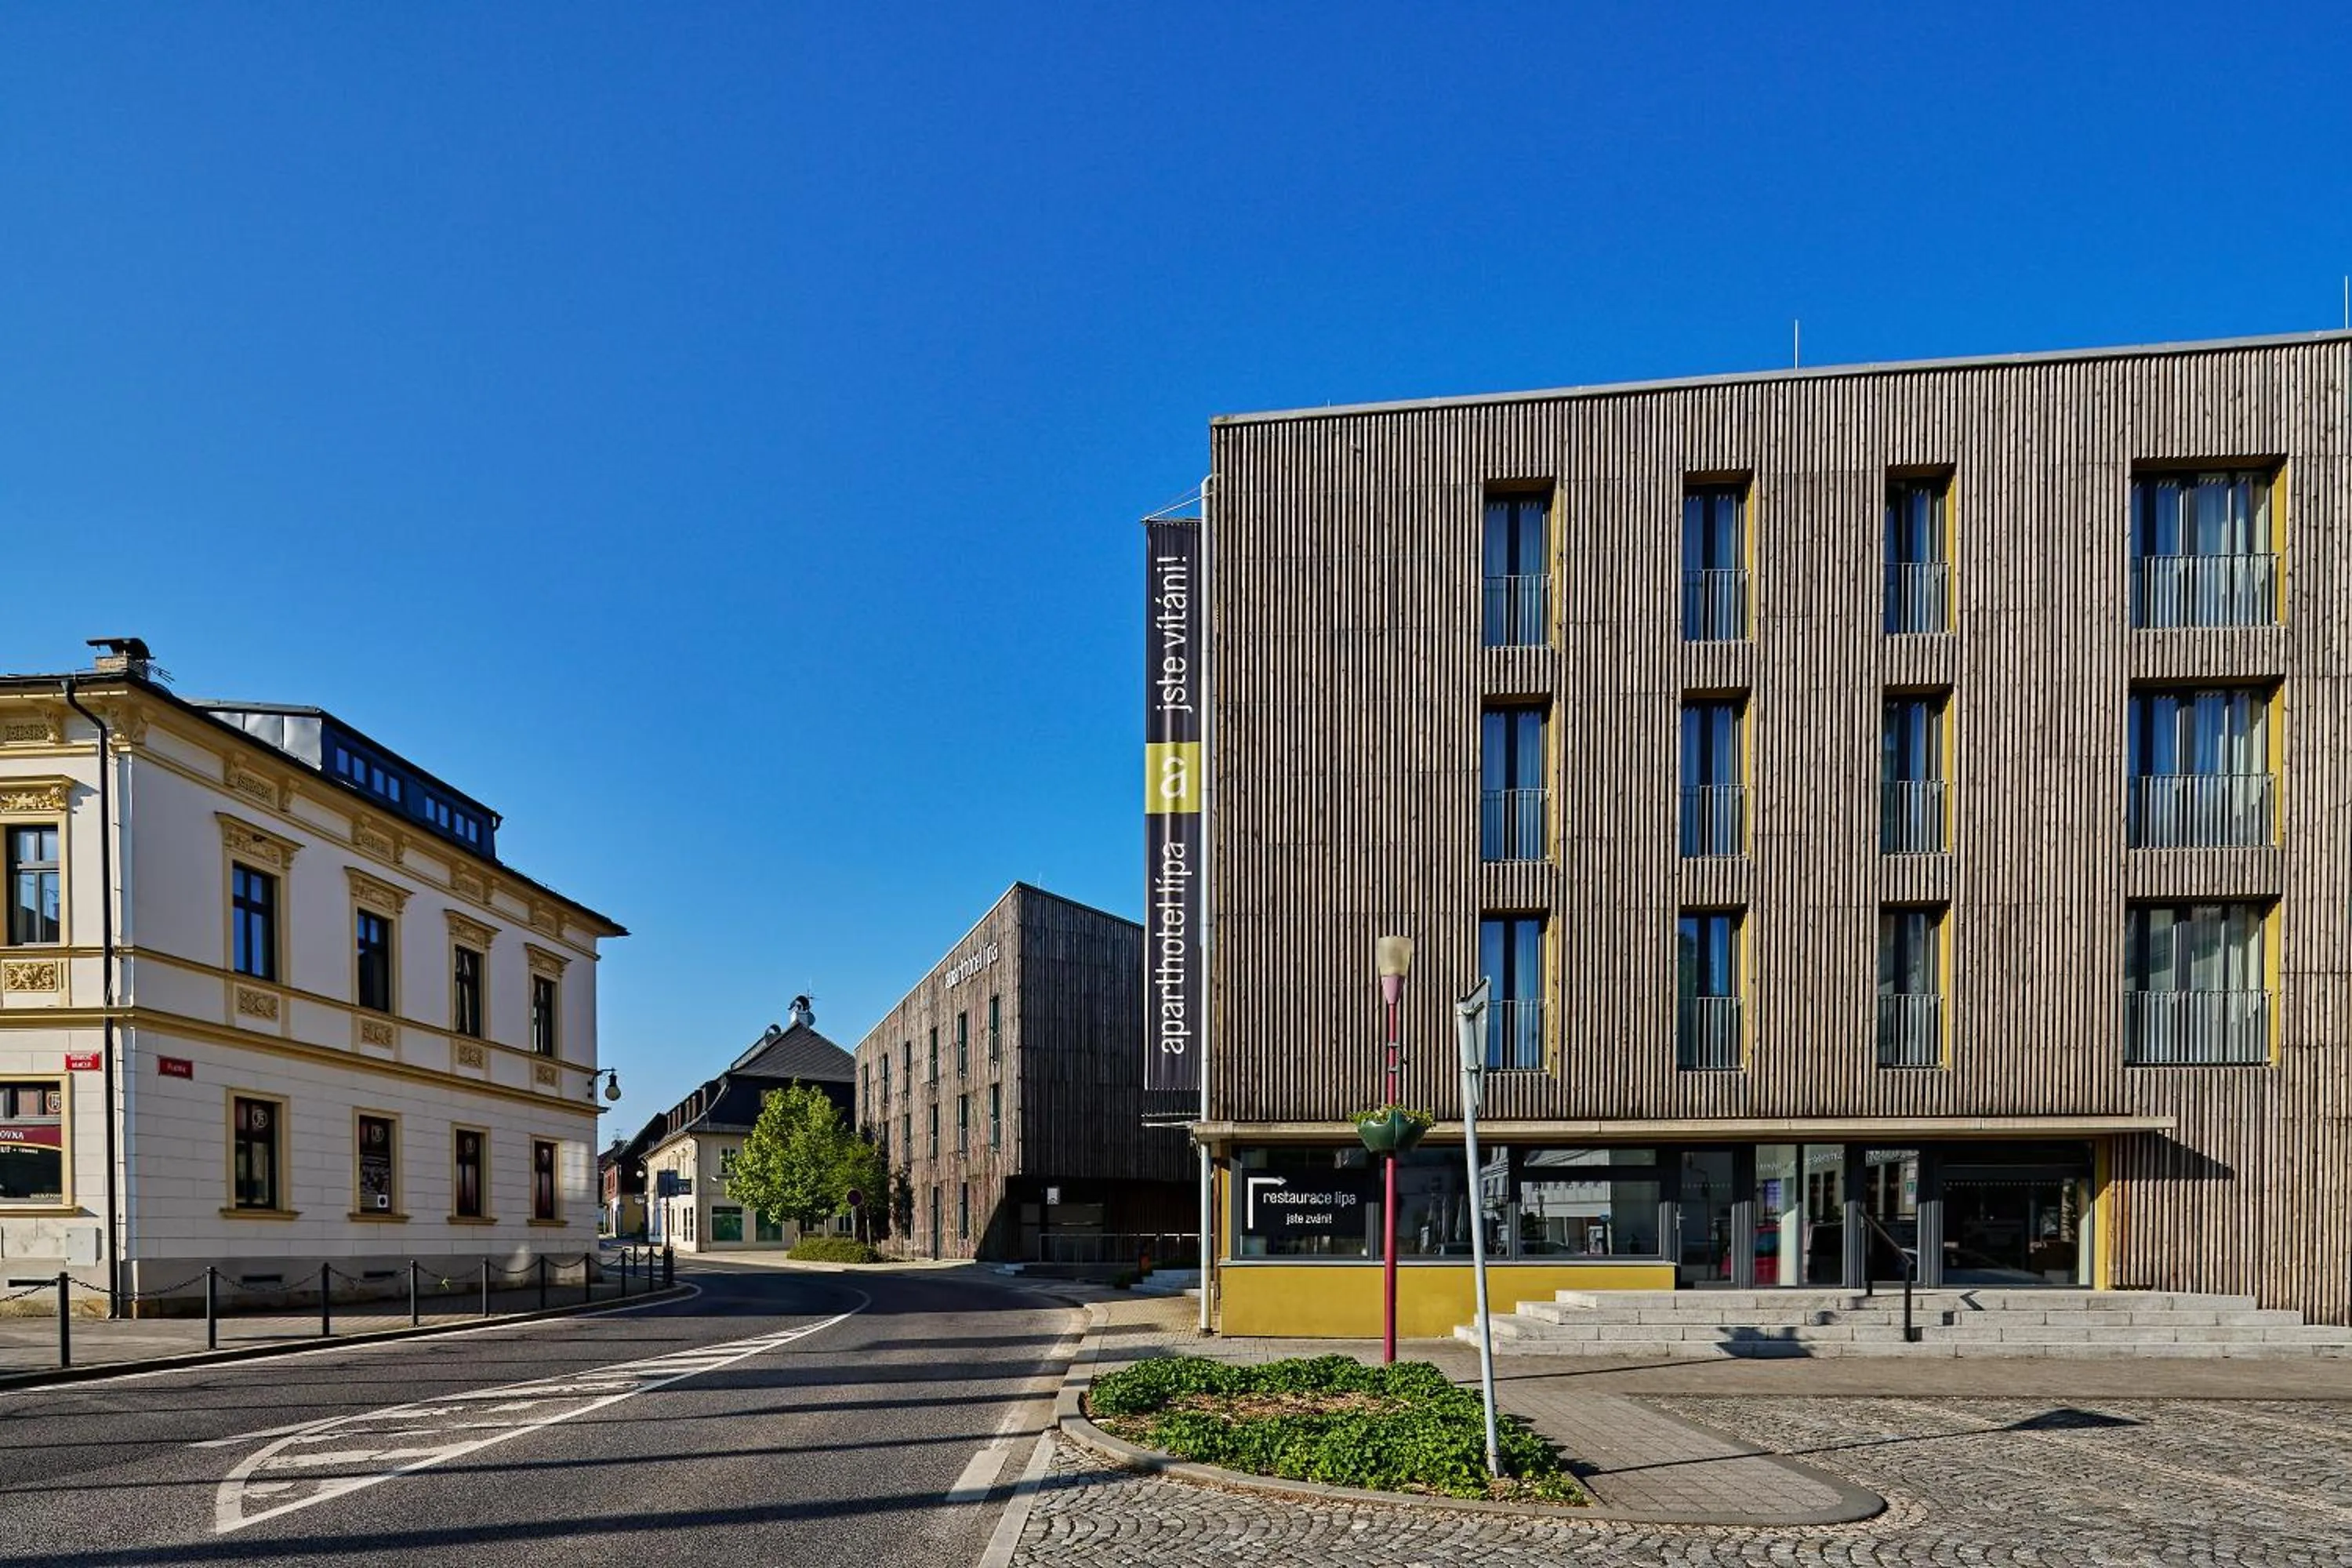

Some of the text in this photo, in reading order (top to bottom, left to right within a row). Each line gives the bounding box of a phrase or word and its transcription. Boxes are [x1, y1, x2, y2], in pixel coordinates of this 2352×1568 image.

[1155, 556, 1192, 713] jste vítáni!
[1160, 756, 1187, 800] a
[1155, 842, 1192, 1054] aparthotel lípa
[1263, 1190, 1332, 1204] restaurace
[1286, 1213, 1303, 1225] jste
